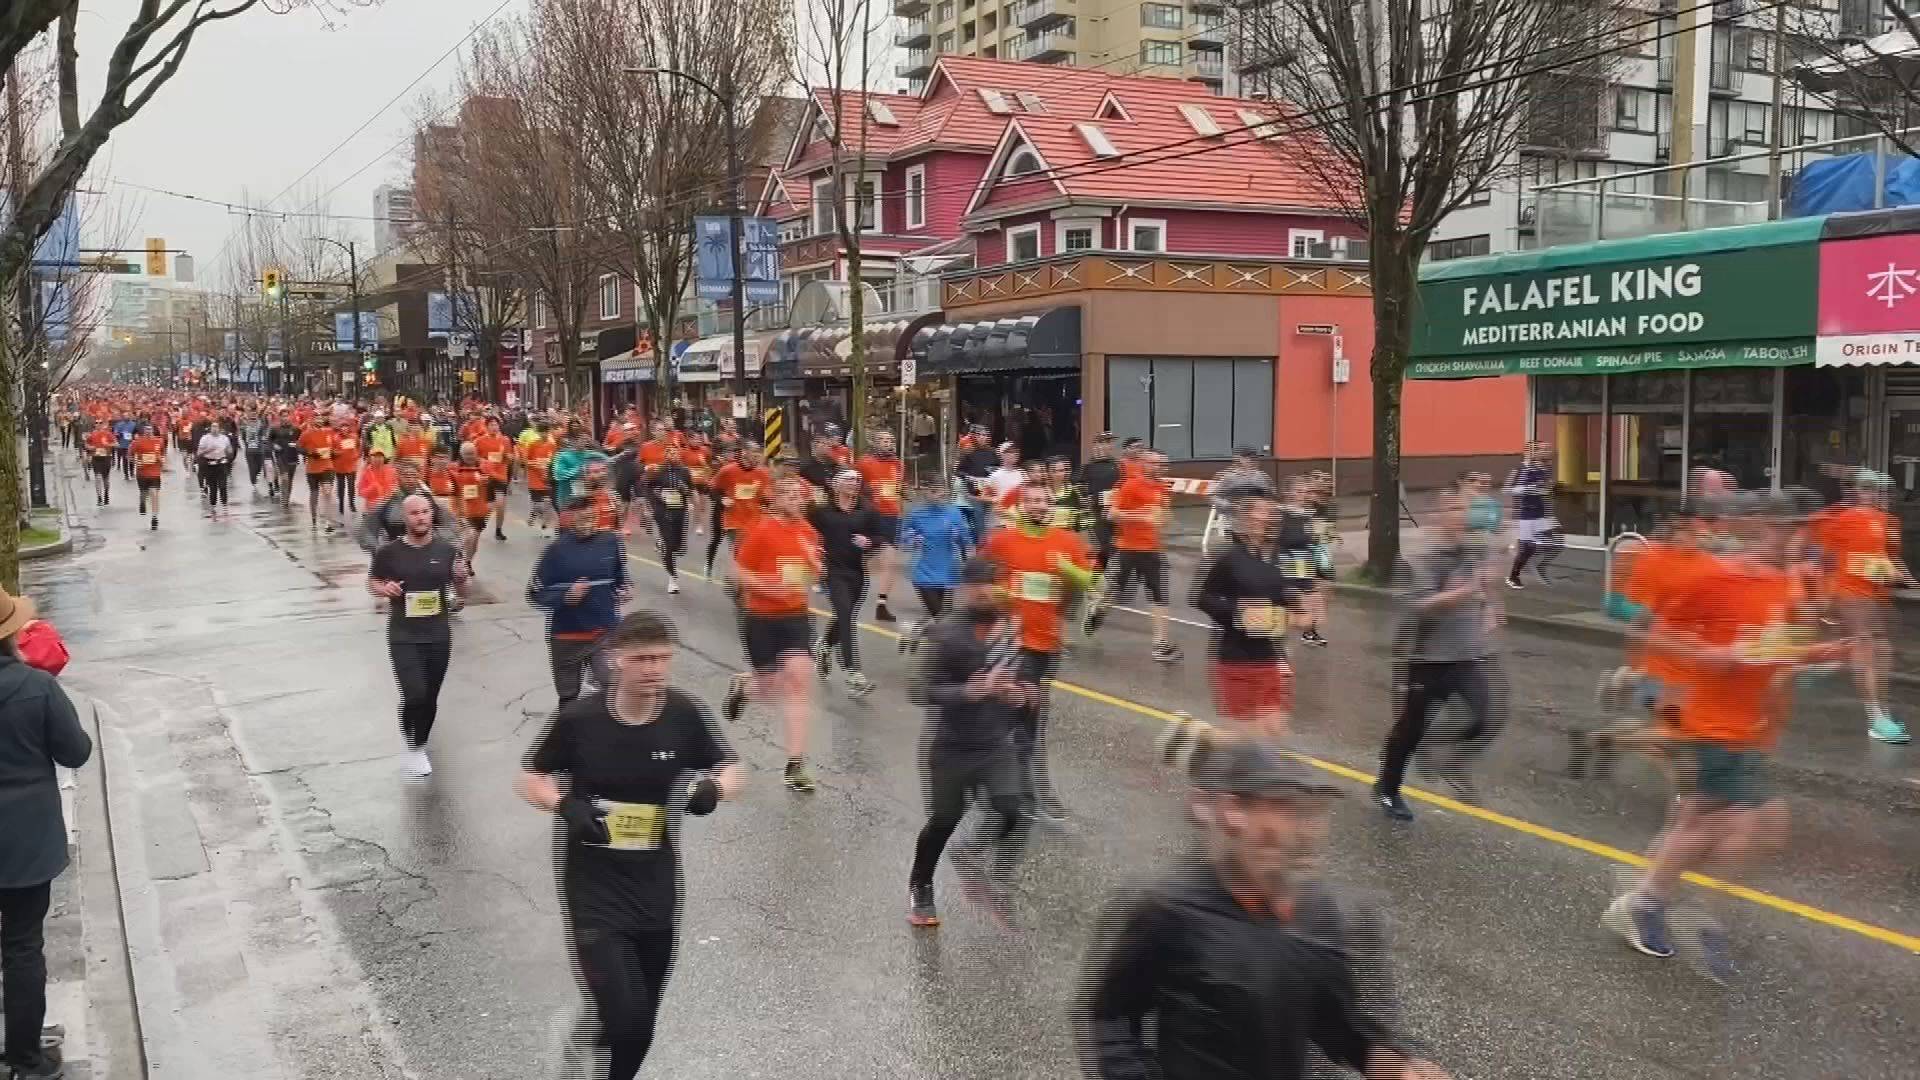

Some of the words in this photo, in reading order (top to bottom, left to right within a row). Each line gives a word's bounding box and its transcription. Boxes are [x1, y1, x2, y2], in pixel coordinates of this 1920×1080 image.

[1463, 273, 1600, 316] FALAFEL
[1611, 263, 1702, 303] KING
[1463, 316, 1627, 346] MEDITERRANIAN
[1638, 311, 1705, 335] FOOD
[1415, 361, 1450, 373] CHICKEN
[1452, 359, 1505, 372] SHAWARMA
[1519, 357, 1541, 369] BEEF
[1543, 357, 1583, 368] DONAIR
[1596, 353, 1641, 367] SPINACH
[1644, 351, 1664, 363] PIE
[1842, 343, 1898, 356] ORIGIN
